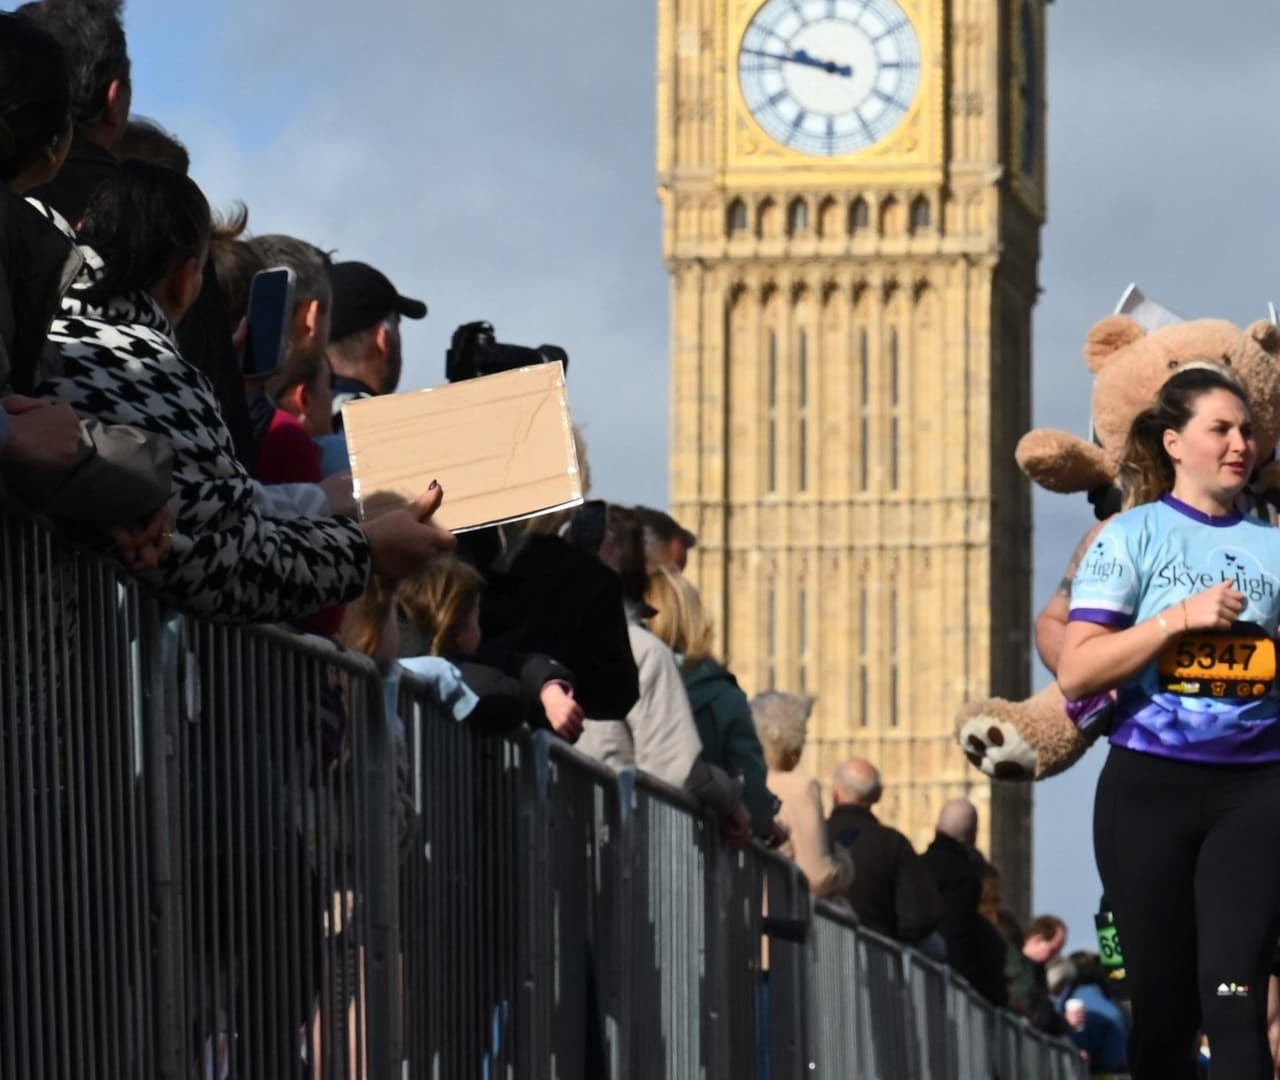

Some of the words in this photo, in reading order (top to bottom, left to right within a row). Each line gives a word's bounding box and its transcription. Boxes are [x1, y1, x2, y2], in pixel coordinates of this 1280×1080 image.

[1085, 557, 1123, 579] High
[1155, 565, 1214, 594] Skye
[1175, 642, 1257, 670] 5347
